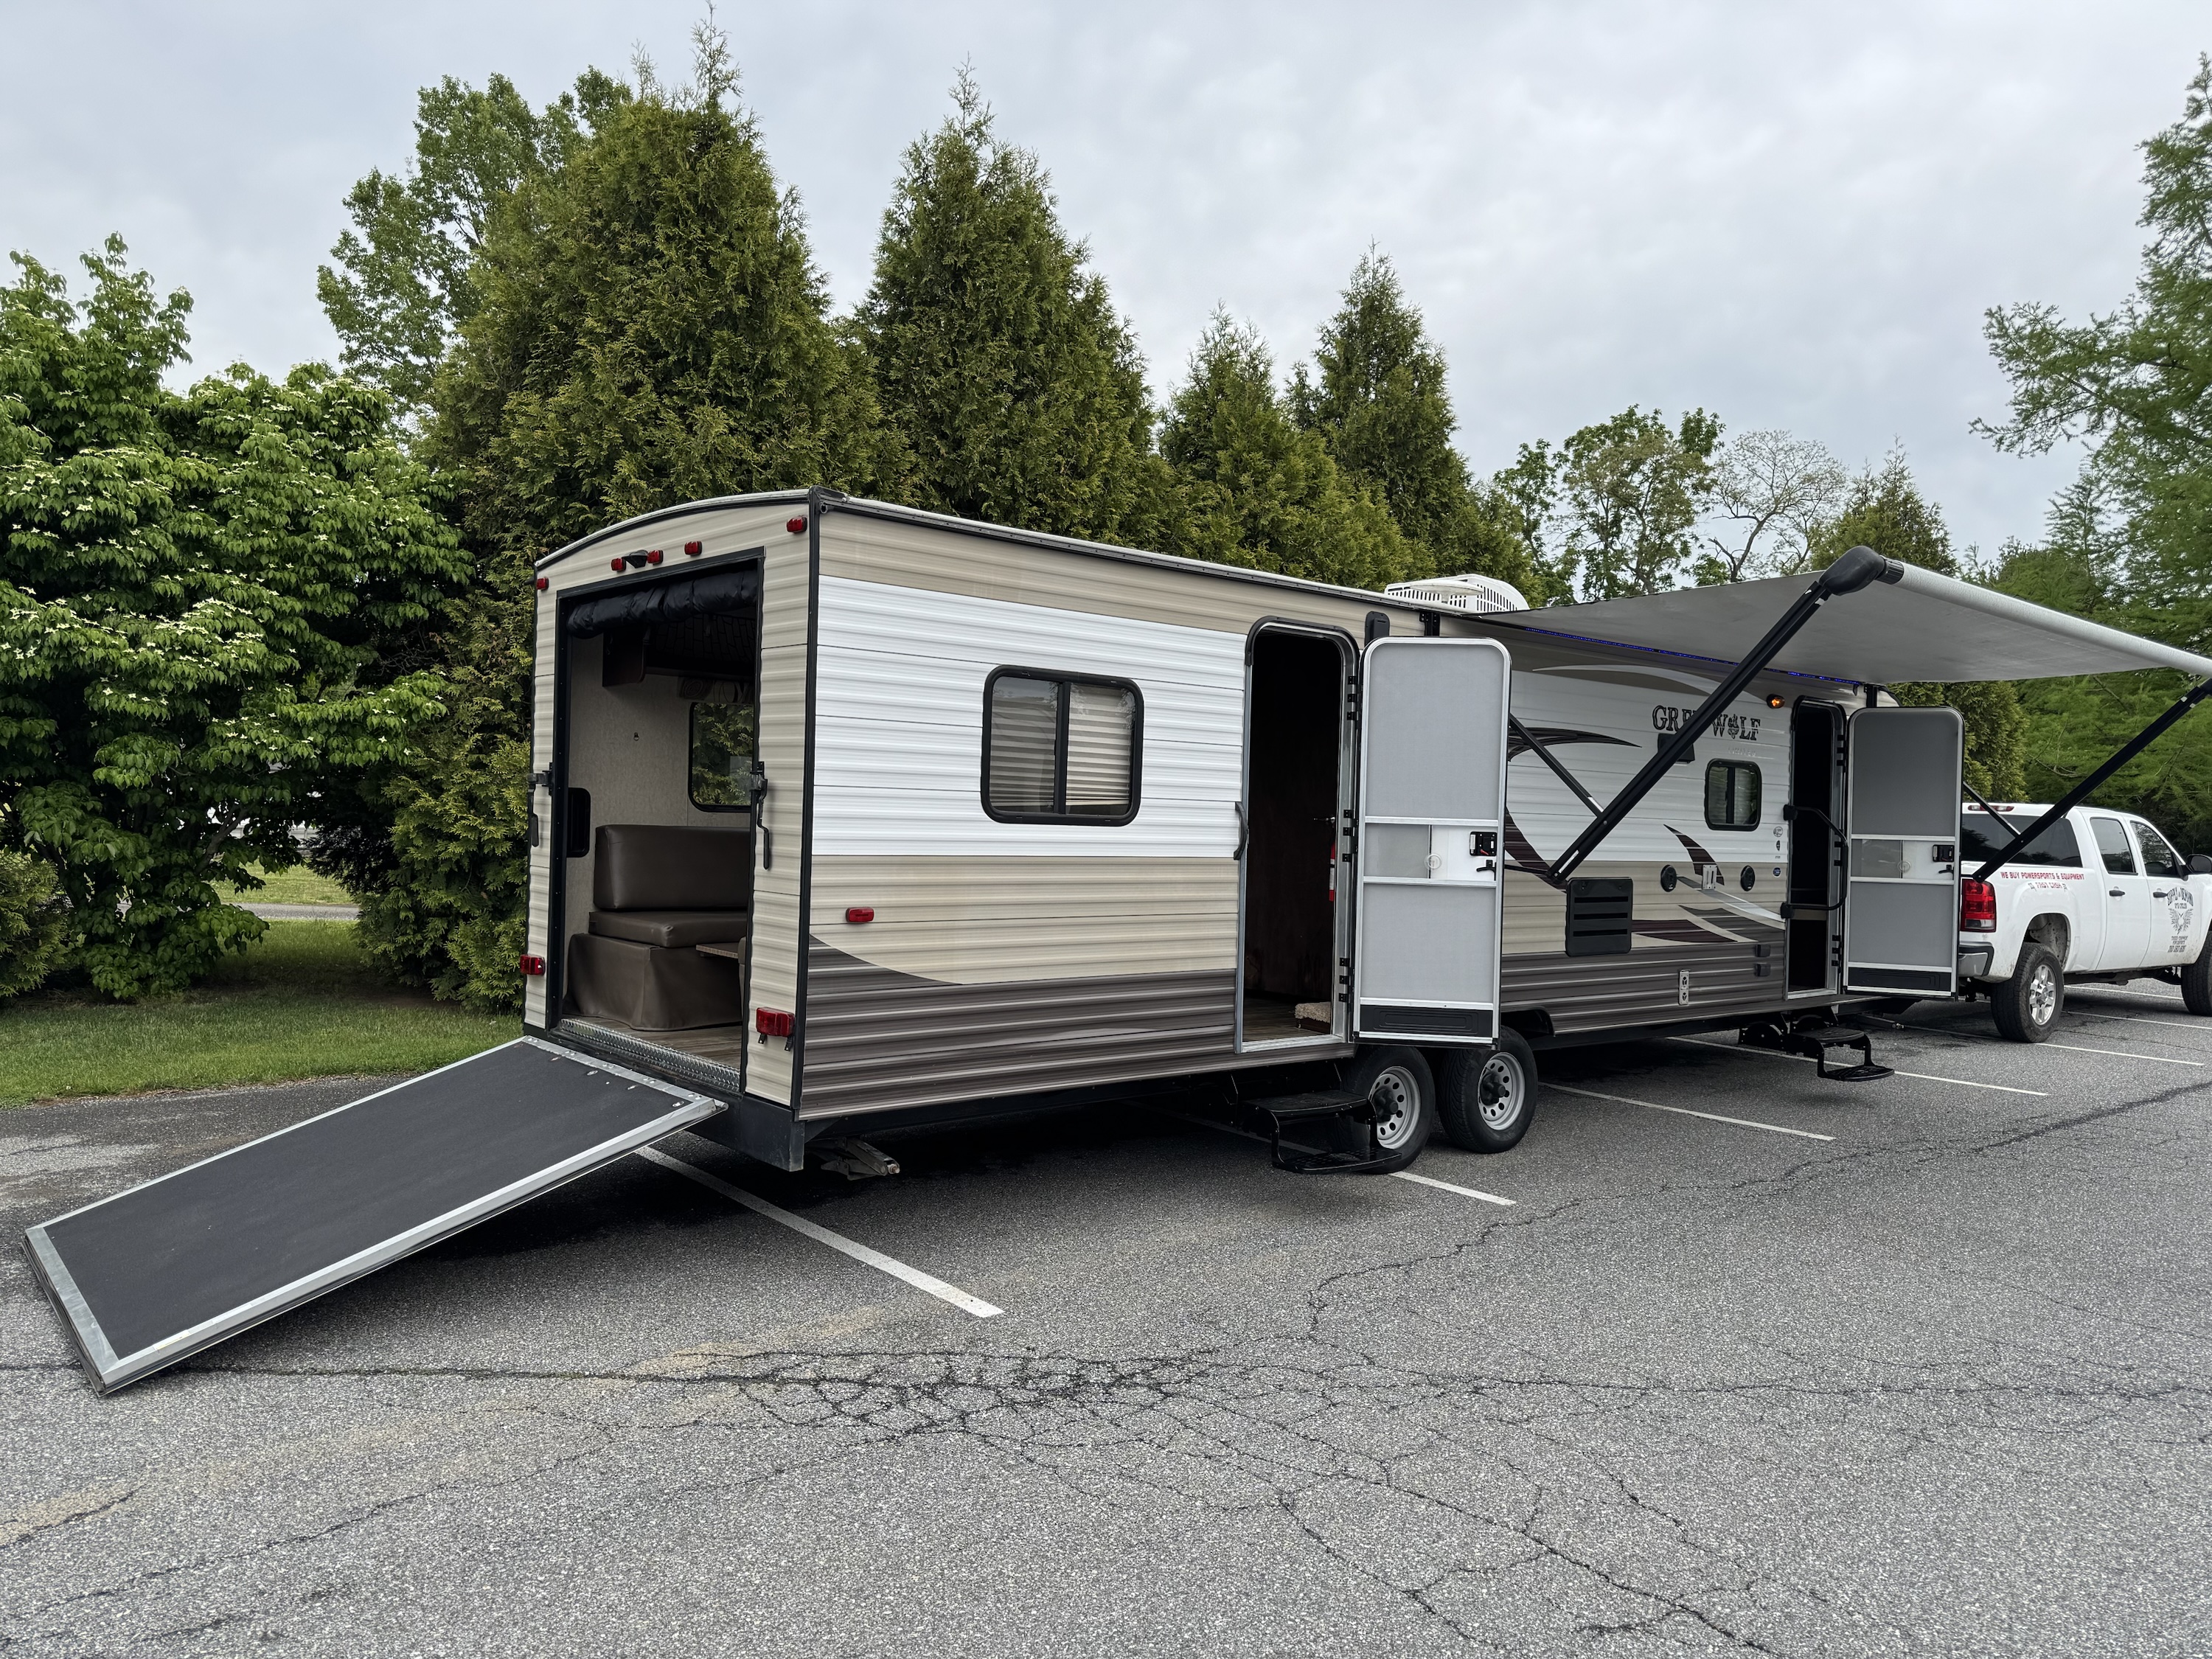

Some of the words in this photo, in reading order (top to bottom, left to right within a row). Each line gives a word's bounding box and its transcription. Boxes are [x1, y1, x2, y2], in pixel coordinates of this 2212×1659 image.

[1652, 705, 1697, 734] GRE
[2020, 872, 2056, 880] POWERSPORTS
[2167, 887, 2178, 906] SUPPLY
[2180, 887, 2194, 907] DEMAND
